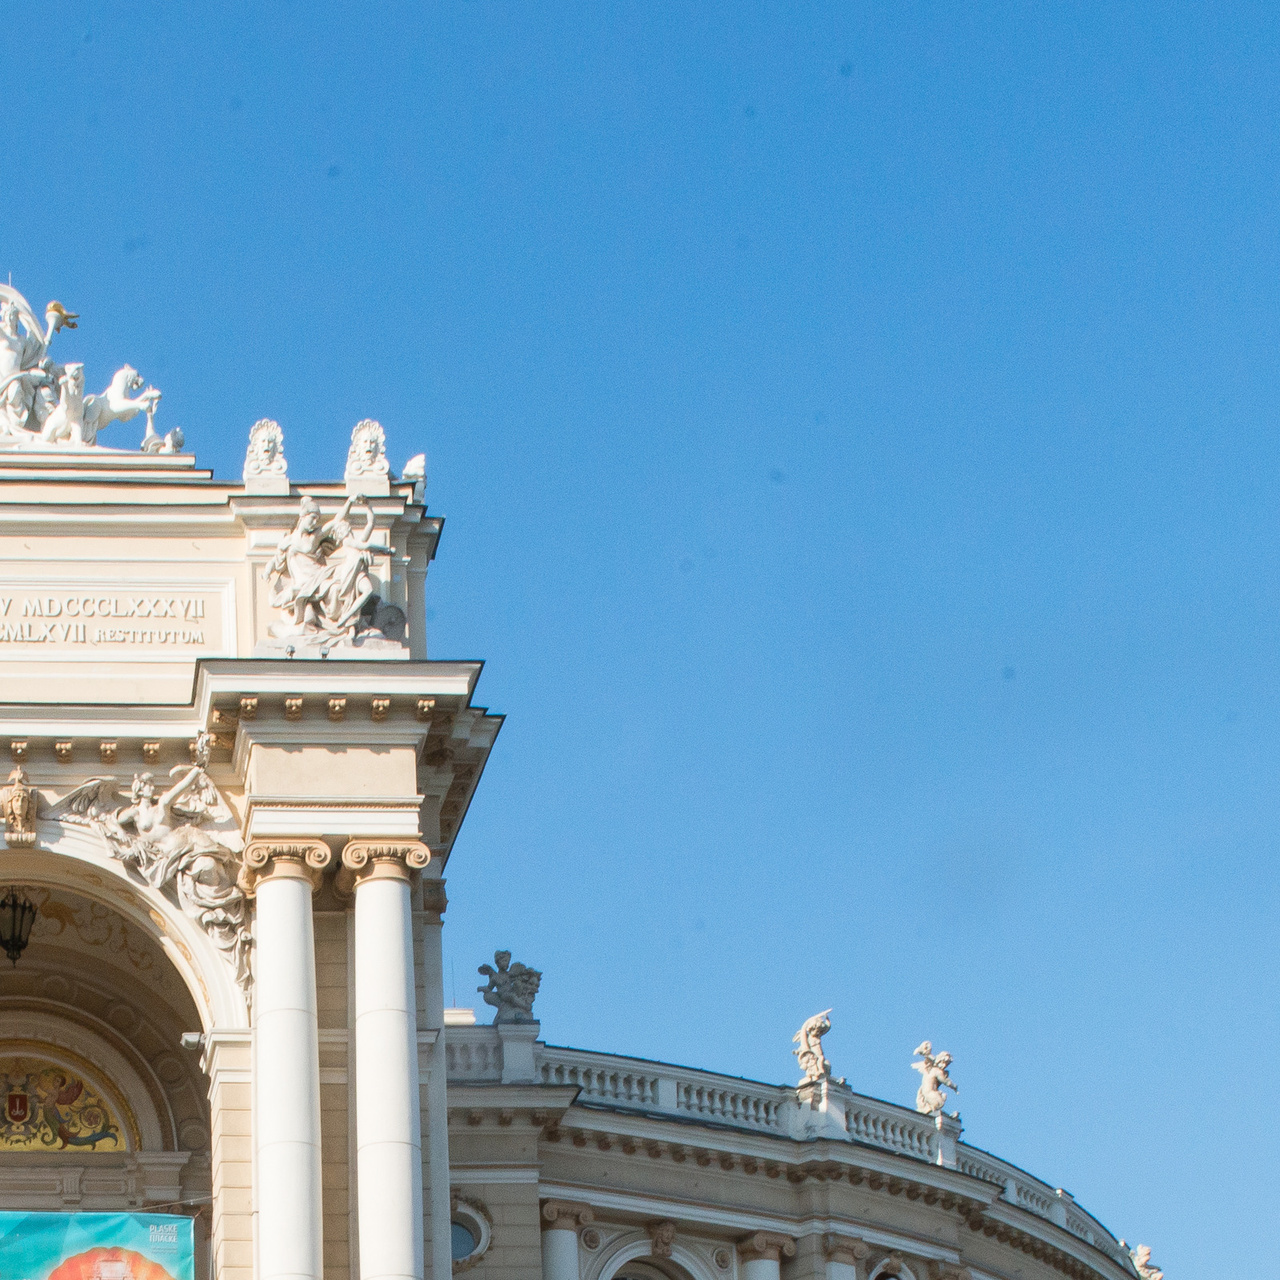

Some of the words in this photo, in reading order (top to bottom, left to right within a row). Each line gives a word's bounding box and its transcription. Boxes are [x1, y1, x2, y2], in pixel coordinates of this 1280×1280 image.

[22, 597, 206, 619] MDCCCLXXXVII
[95, 629, 206, 645] RESTITUTUM
[149, 1224, 178, 1234] PLASKE
[149, 1234, 178, 1243] ПЛАСКЕ
